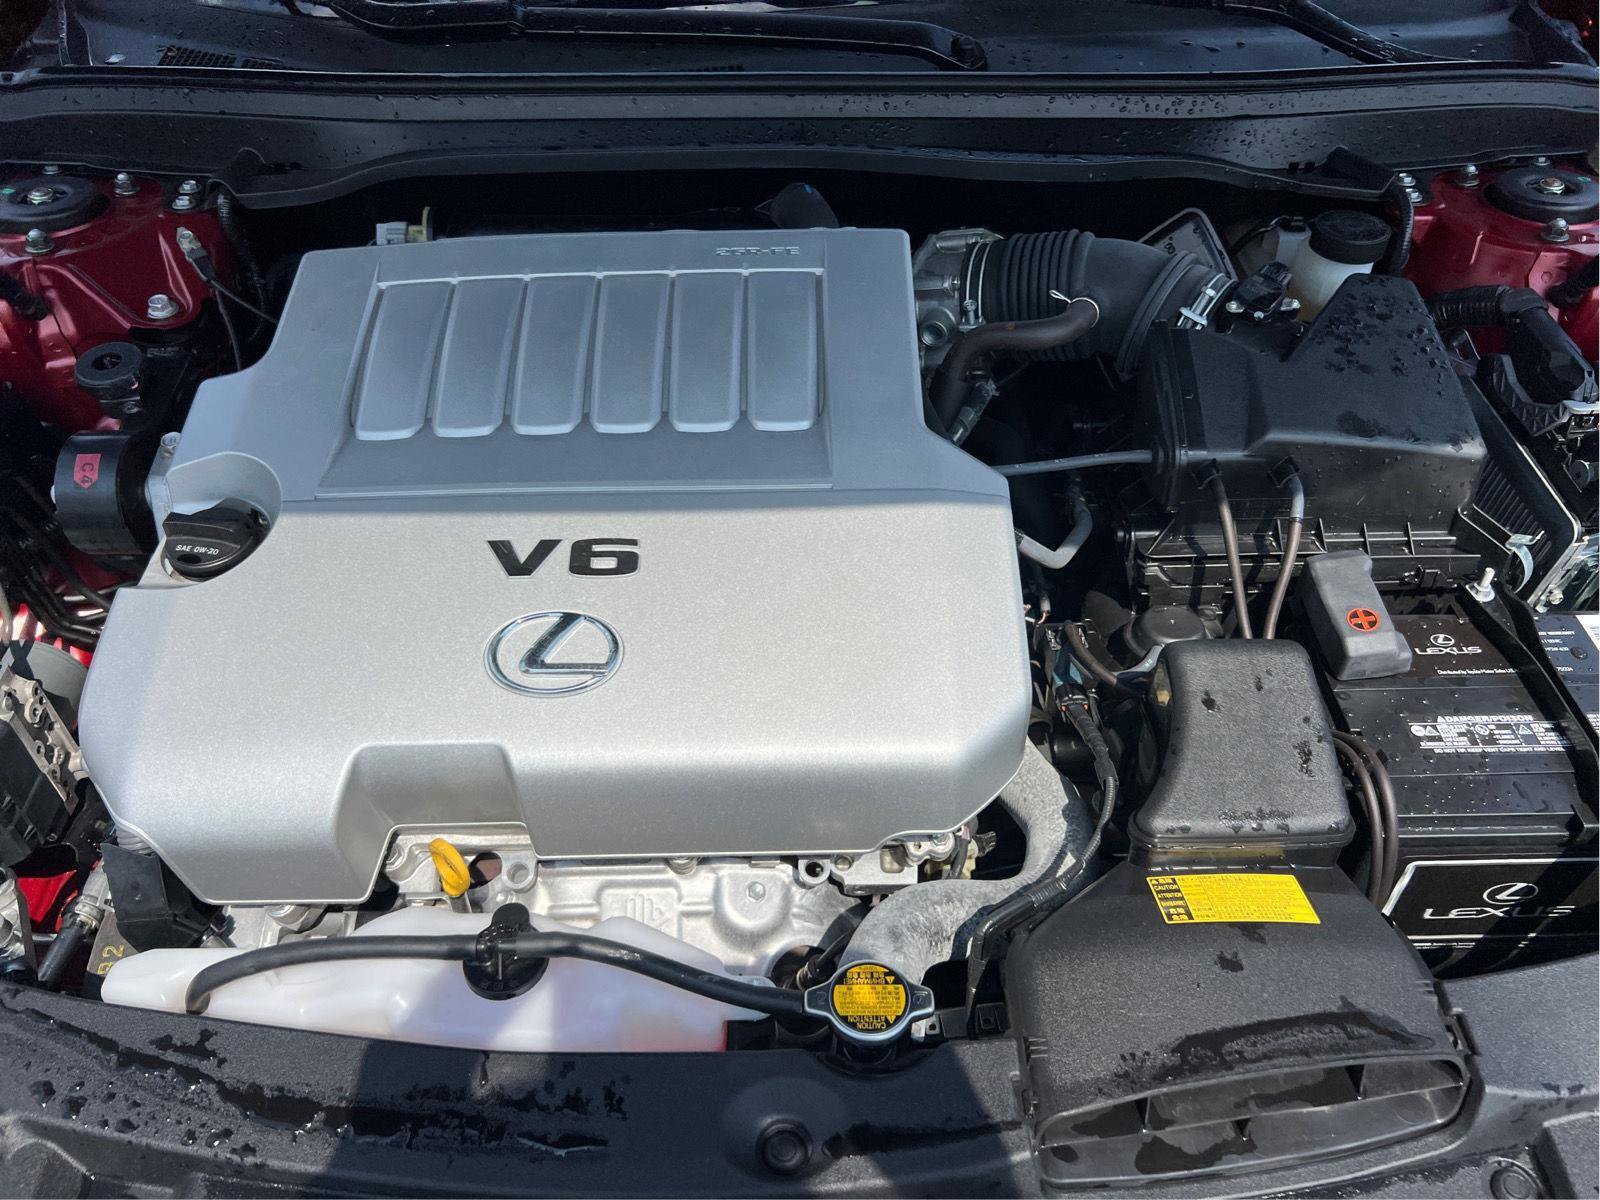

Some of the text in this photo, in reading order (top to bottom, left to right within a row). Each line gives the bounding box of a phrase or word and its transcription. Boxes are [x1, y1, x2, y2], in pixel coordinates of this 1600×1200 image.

[194, 547, 219, 555] 0W-20
[487, 538, 640, 577] V6
[1414, 646, 1482, 655] LEXUS
[1423, 905, 1576, 919] LEXUS
